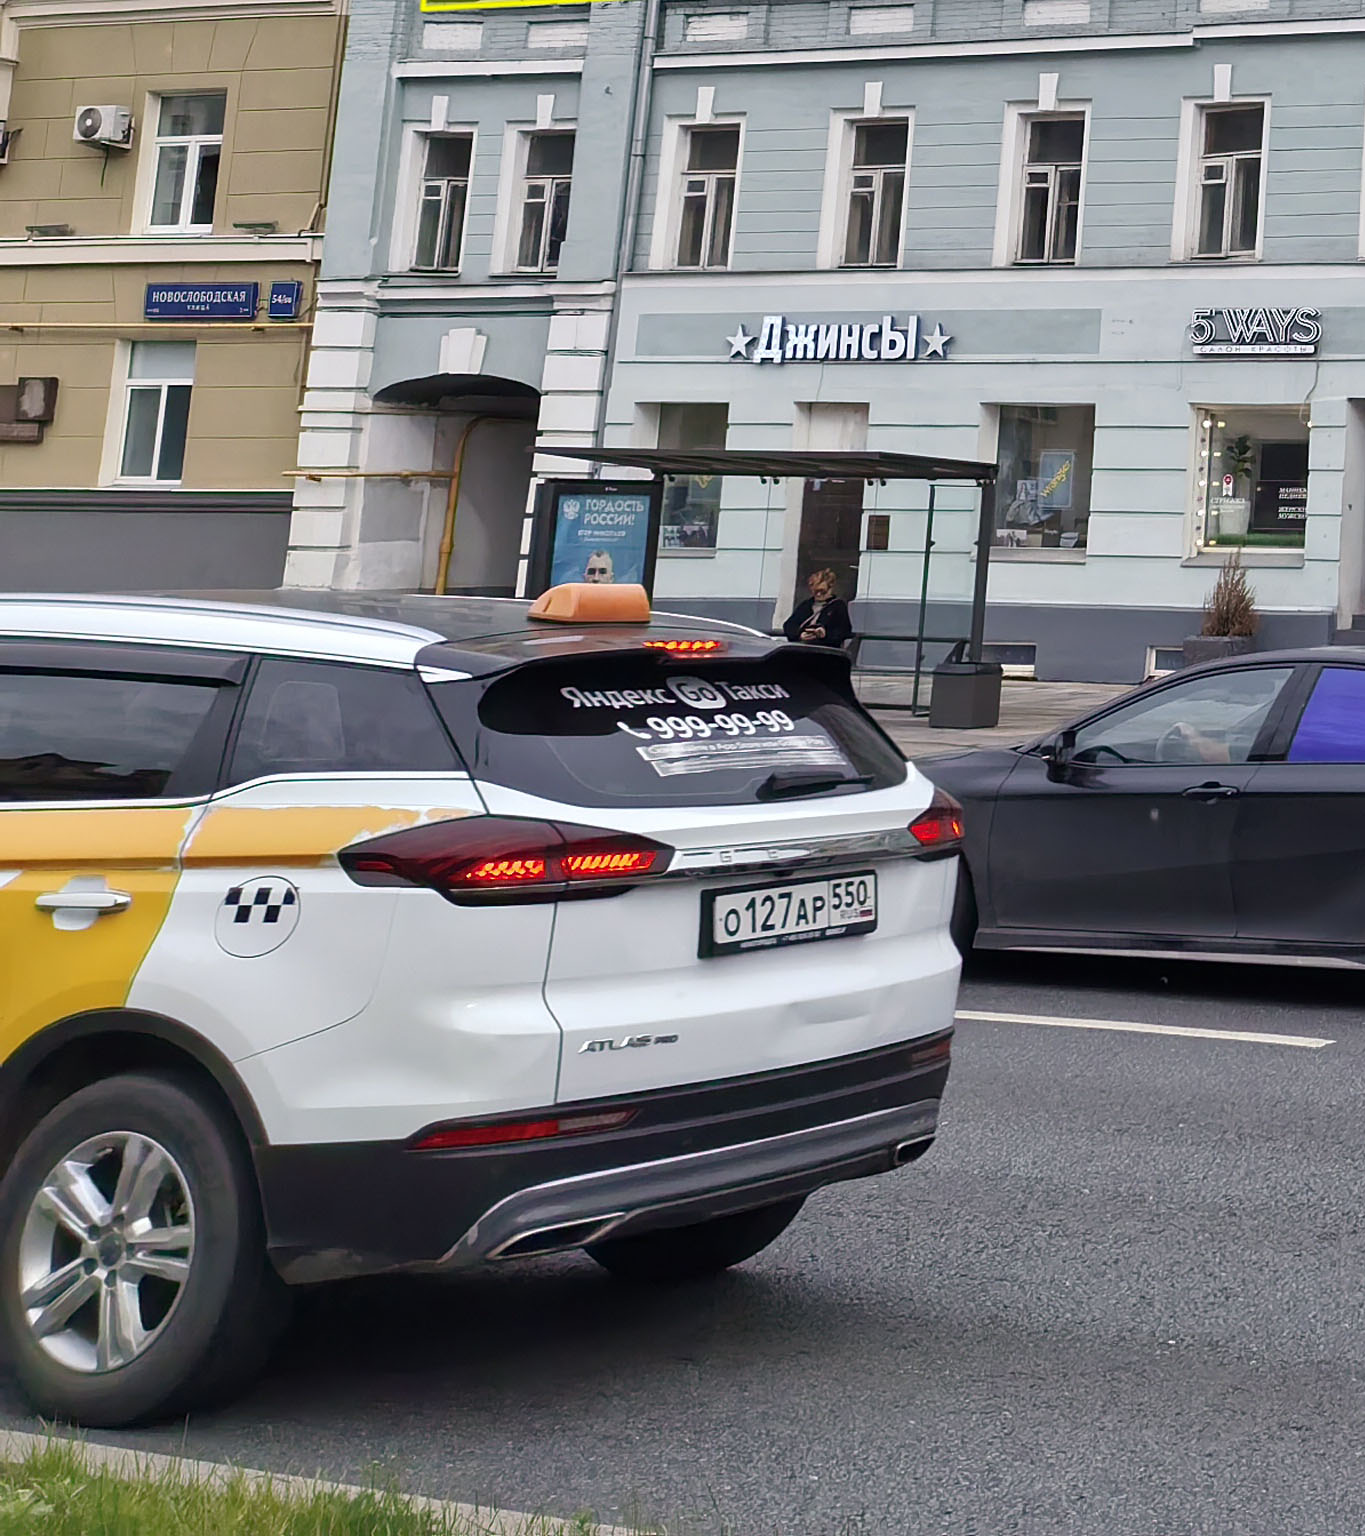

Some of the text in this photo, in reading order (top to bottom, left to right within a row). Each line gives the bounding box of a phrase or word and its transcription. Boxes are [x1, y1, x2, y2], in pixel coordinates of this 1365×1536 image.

[151, 290, 247, 303] НОВОСЛОБОДСКАЯ
[1221, 306, 1323, 345] WAYS
[583, 512, 636, 526] РОССИИ!
[585, 498, 645, 513] ГОРДОСТЬ
[560, 686, 677, 709] Яндекс
[714, 681, 791, 701] Такси
[646, 709, 796, 740] 999-99-99
[831, 879, 868, 910] 550
